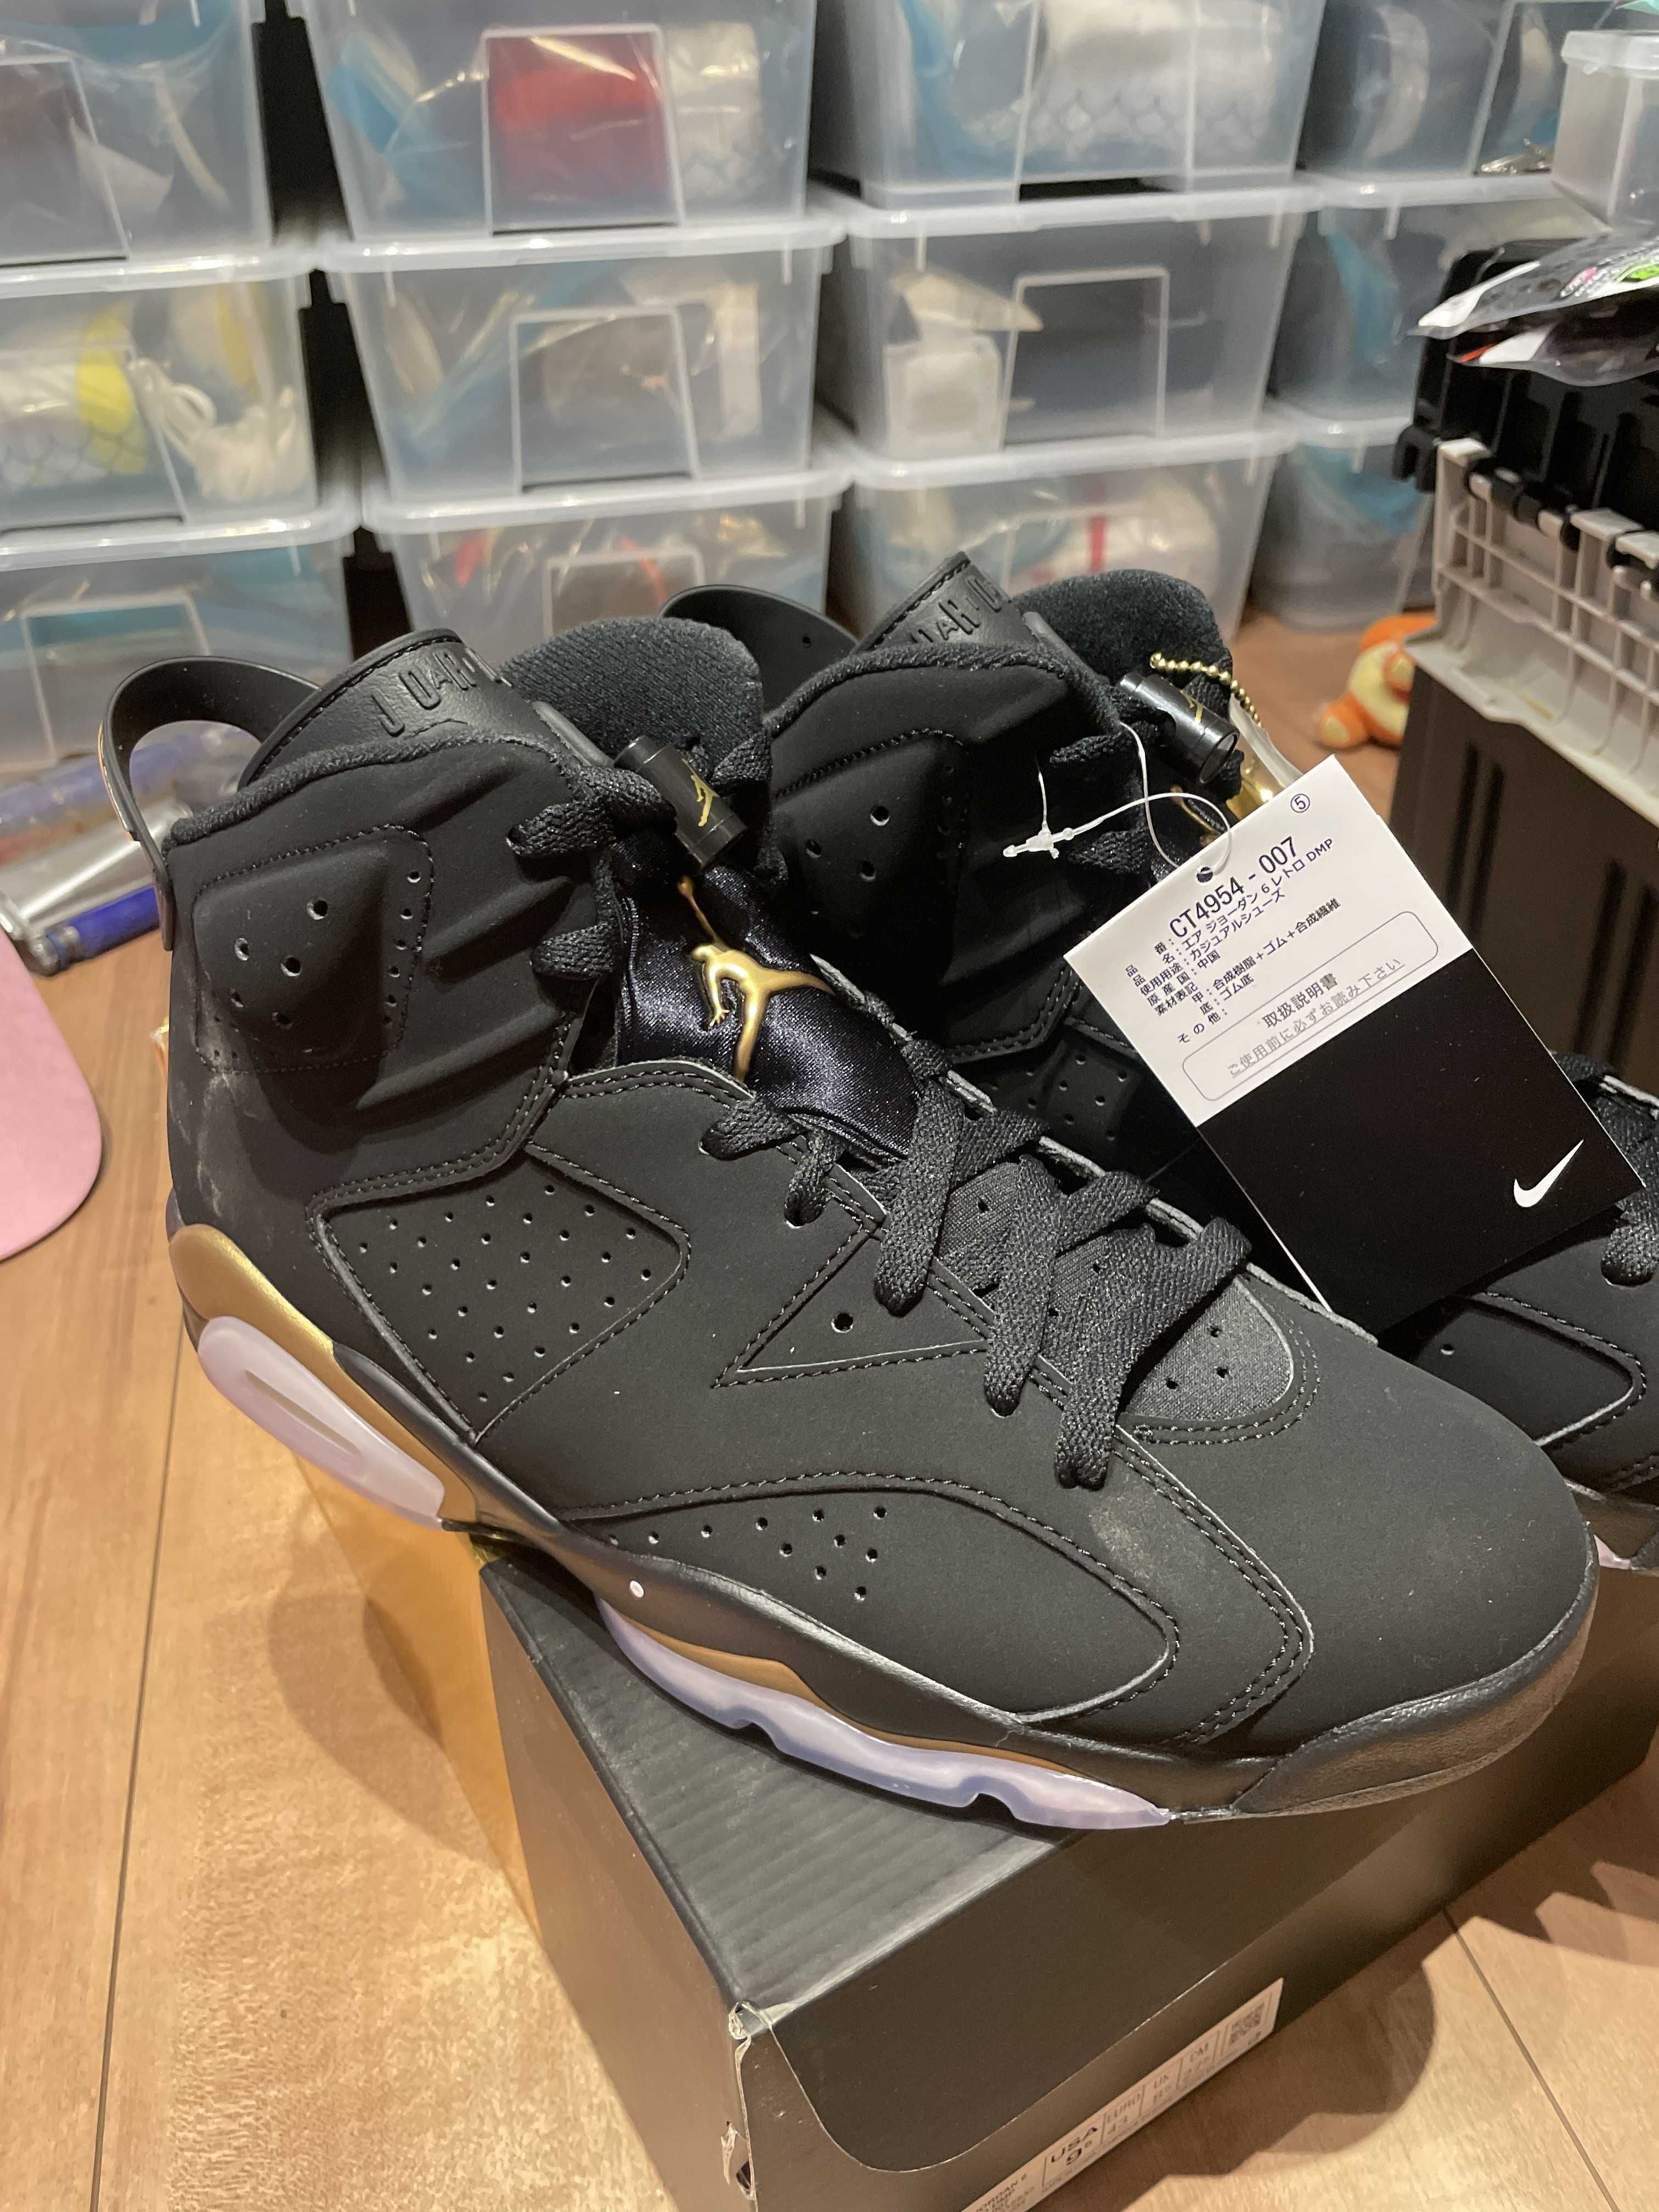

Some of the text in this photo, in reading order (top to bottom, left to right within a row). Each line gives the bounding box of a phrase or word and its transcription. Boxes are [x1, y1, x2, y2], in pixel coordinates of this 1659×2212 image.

[1170, 877, 1244, 938] CT4954
[1259, 836, 1296, 873] 007
[1182, 930, 1201, 951] エア
[1206, 893, 1257, 933] ジョーダン
[1271, 859, 1306, 885] レトロ
[1306, 838, 1333, 862] DMP
[1190, 887, 1285, 961] カジュアルシューズ
[1197, 950, 1221, 969] 中国
[1220, 973, 1254, 1001] ゴム底
[1154, 982, 1198, 1016] 素材表記
[1228, 959, 1401, 1076] ご使用前に必ずお読み下さい
[1262, 973, 1338, 1028] 取扱説明書
[1051, 2126, 1097, 2163] USA
